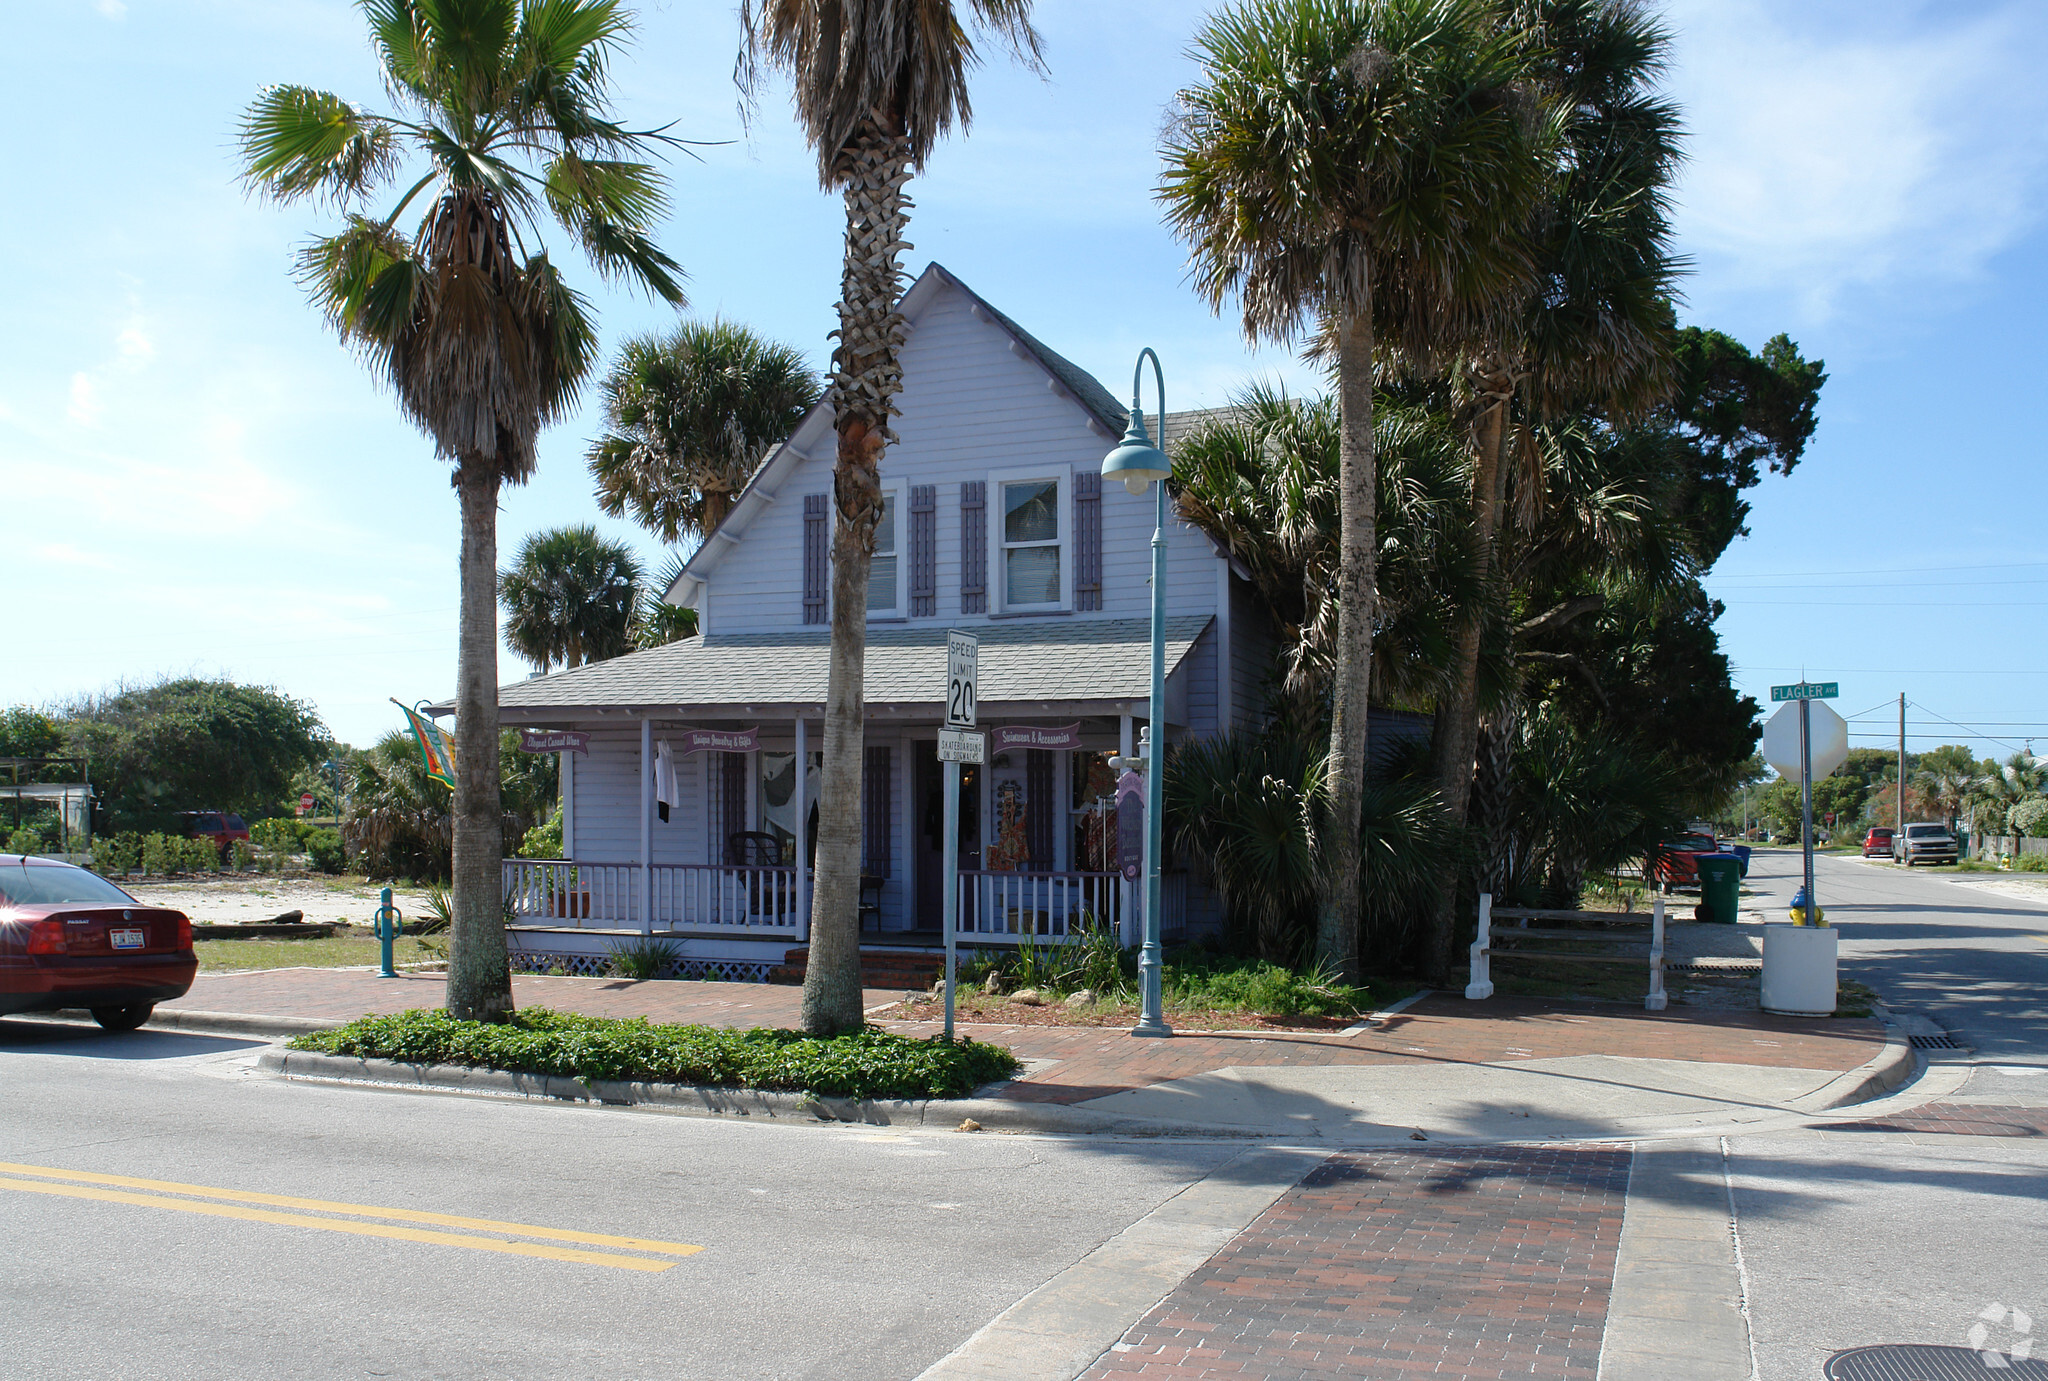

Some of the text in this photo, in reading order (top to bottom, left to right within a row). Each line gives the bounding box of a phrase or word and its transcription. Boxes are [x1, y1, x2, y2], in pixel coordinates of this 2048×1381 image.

[951, 641, 976, 658] SPEED
[953, 662, 973, 678] LIMIT
[1773, 685, 1837, 700] FLAGLER AVE
[951, 679, 973, 722] 20
[527, 736, 547, 750] Elegant
[548, 735, 566, 747] Casual
[693, 734, 752, 749] Unique Jewelry & Gifts
[1002, 730, 1070, 745] Swimwear & Accessories
